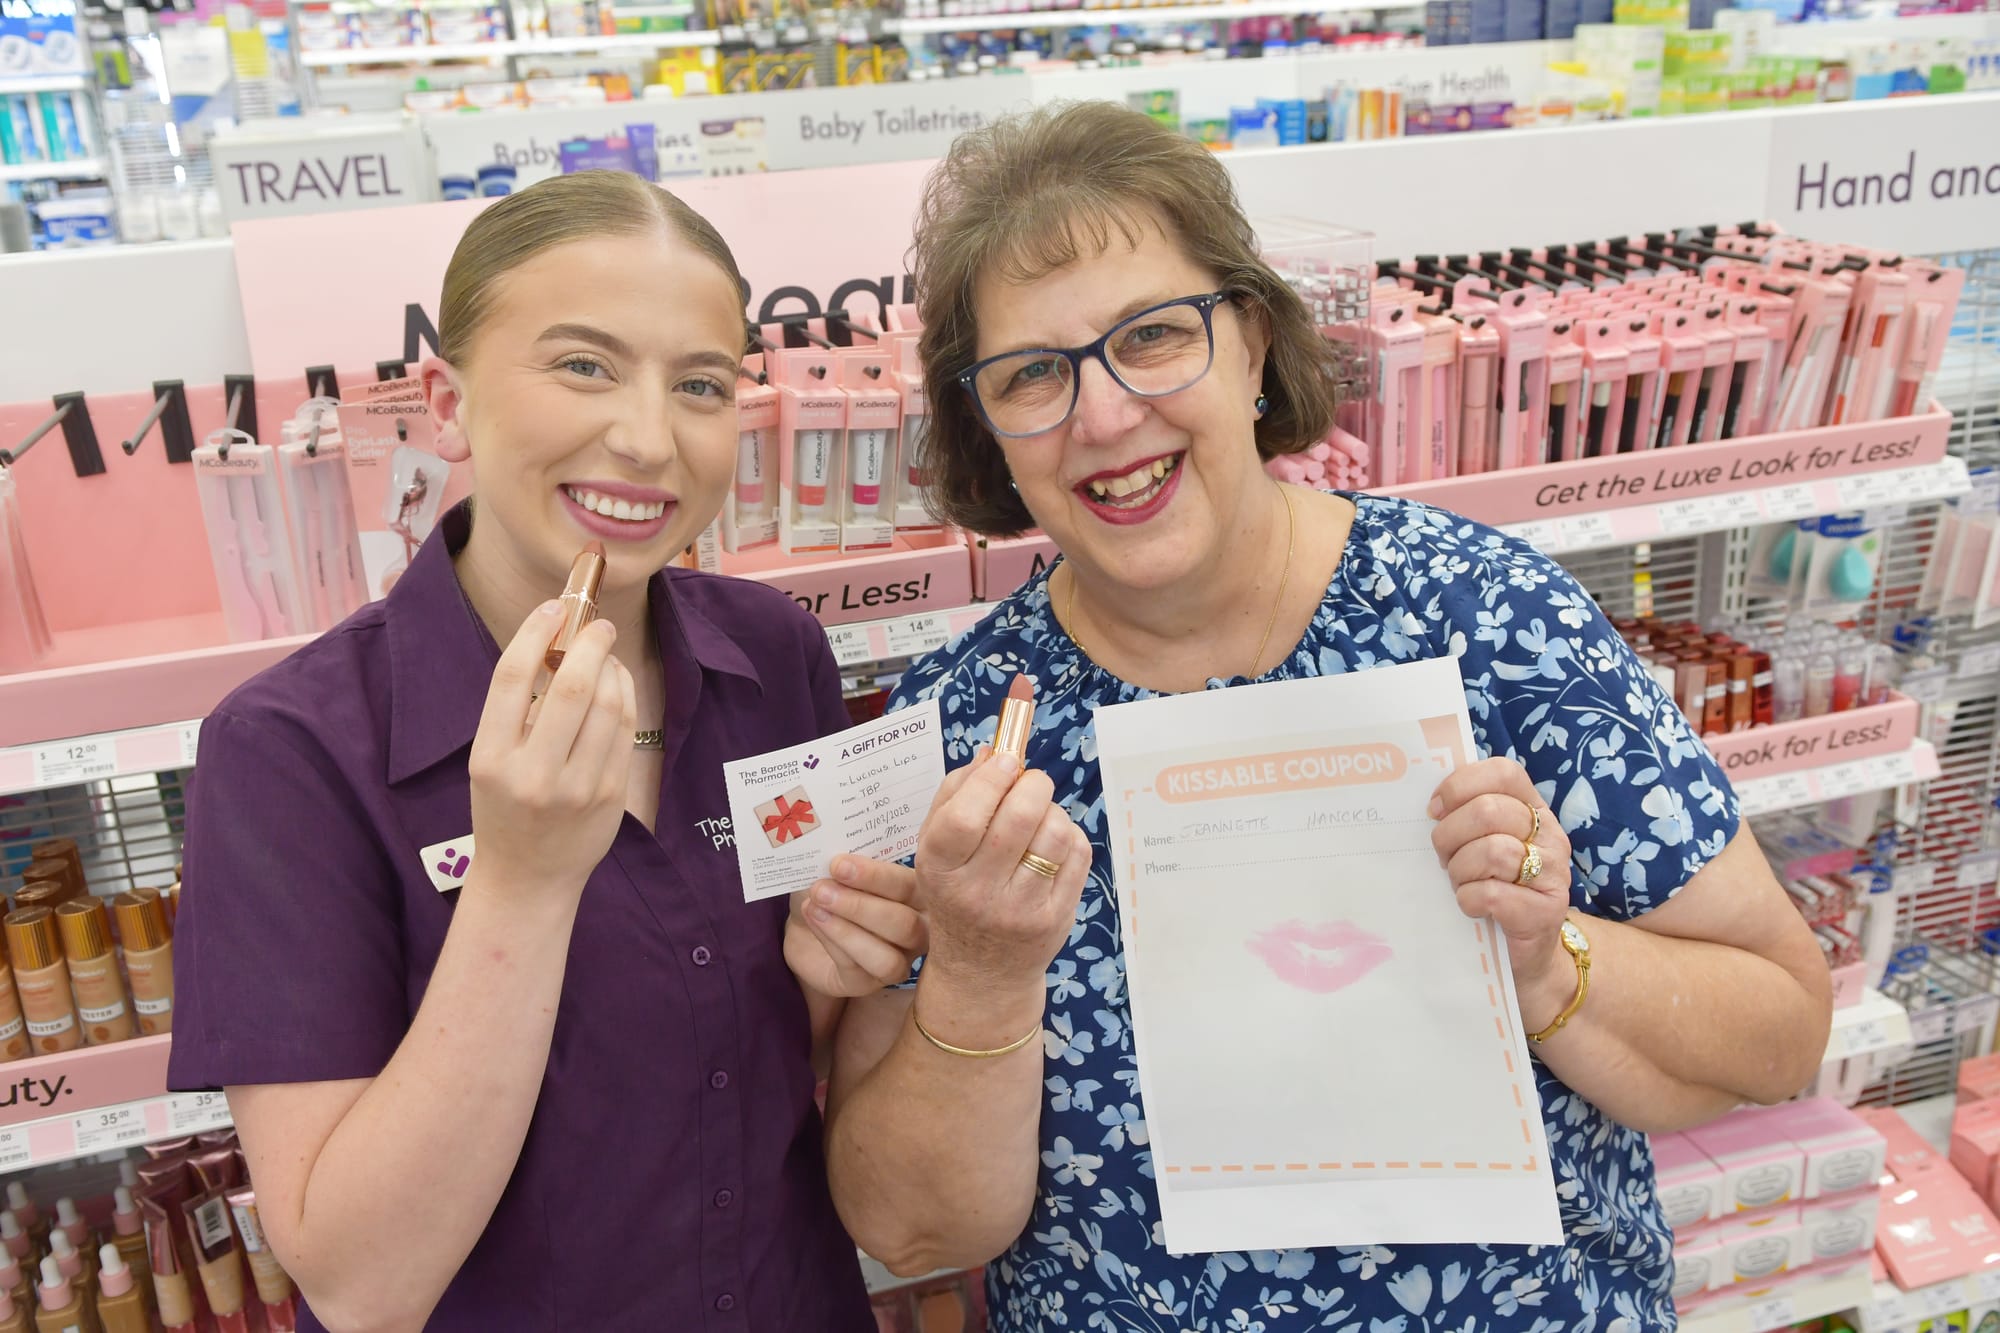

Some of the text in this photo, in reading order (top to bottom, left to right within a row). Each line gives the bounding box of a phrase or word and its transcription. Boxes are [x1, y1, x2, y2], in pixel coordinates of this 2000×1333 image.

[800, 106, 982, 144] Baby Toiletries
[493, 138, 563, 169] Baby
[228, 155, 402, 205] TRAVEL
[1797, 150, 1916, 211] Hand
[366, 405, 428, 416] MCoBeauty
[741, 400, 777, 410] MCoBeauty
[801, 401, 842, 409] MCoBeauty
[855, 401, 897, 409] MCoBeauty
[1535, 435, 1921, 507] Get the Luxe Look for Less!
[785, 573, 931, 614] or Less!
[841, 719, 926, 760] A GIFT FOR YOU
[1783, 735, 1820, 758] for
[1827, 718, 1892, 750] Less!
[739, 760, 798, 780] The Barossa
[744, 767, 800, 786] Pharmacist
[1167, 751, 1394, 795] KISSABLE COUPON
[694, 816, 732, 837] The
[1143, 834, 1176, 848] Name:
[1144, 860, 1181, 875] Phone:
